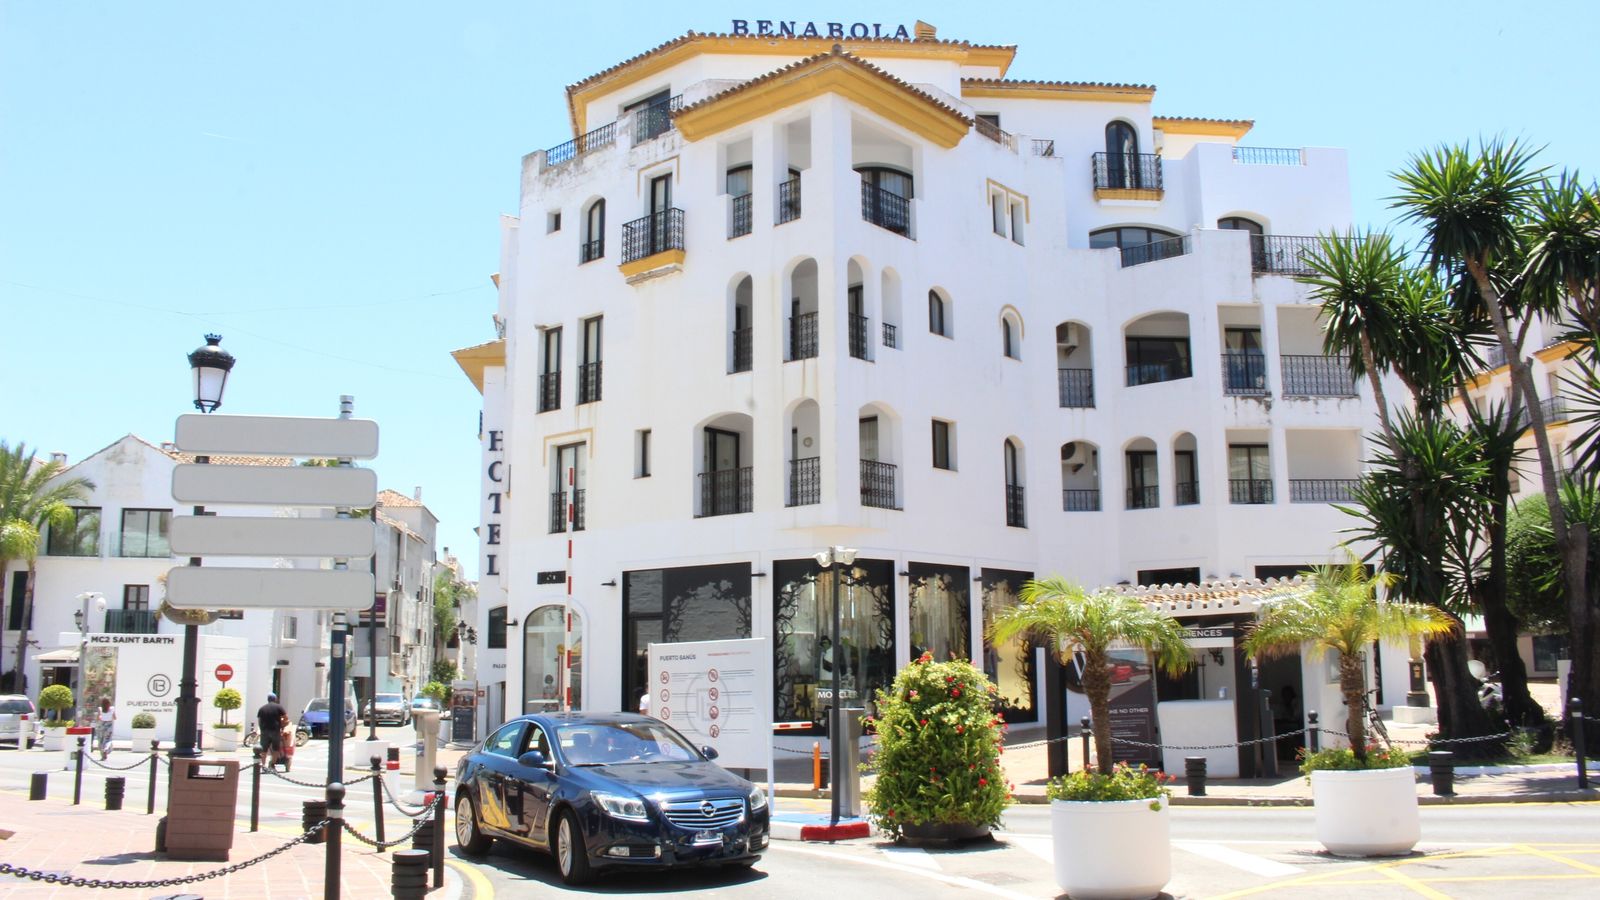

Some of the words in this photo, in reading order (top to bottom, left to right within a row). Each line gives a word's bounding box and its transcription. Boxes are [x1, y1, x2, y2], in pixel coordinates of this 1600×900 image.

[732, 19, 910, 39] BENABOLA
[486, 430, 503, 576] HOTEL
[113, 636, 141, 644] SAINT
[142, 637, 174, 645] BARTH
[817, 690, 858, 699] MOCLER
